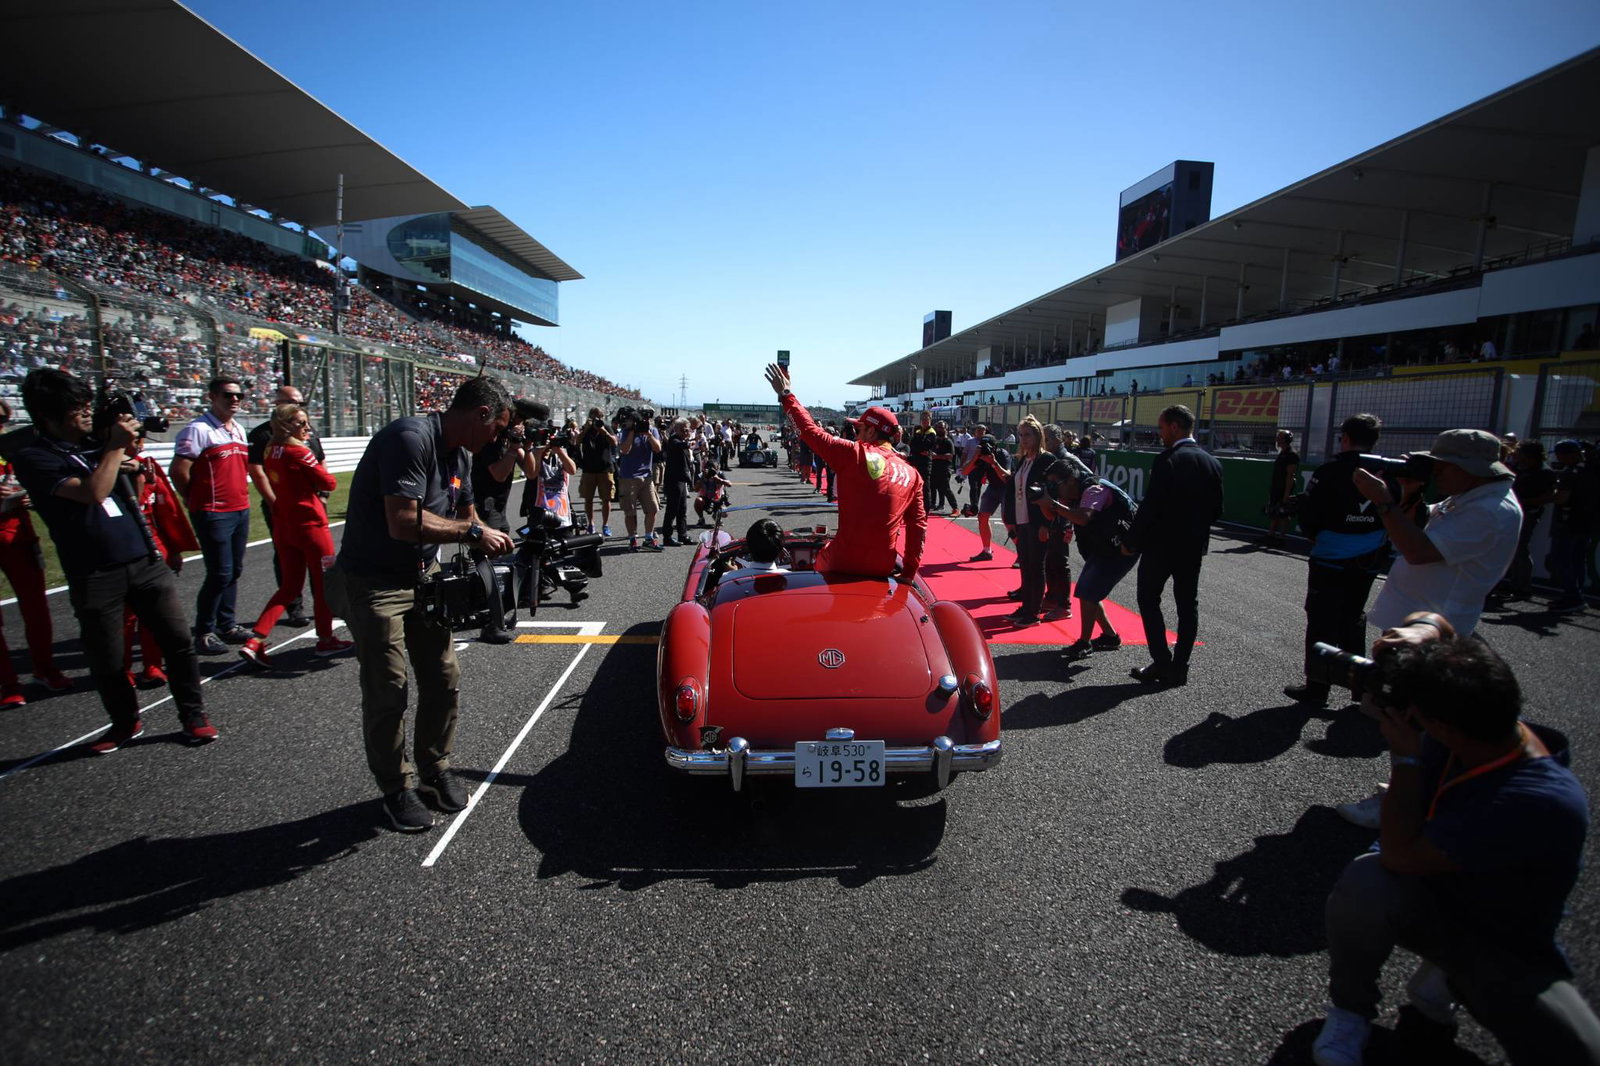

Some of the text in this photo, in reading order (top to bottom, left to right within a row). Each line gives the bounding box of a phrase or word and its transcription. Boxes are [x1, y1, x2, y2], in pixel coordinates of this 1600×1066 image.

[1094, 454, 1145, 501] ken
[1345, 514, 1375, 523] Rexona
[802, 760, 880, 783] ら 19-58
